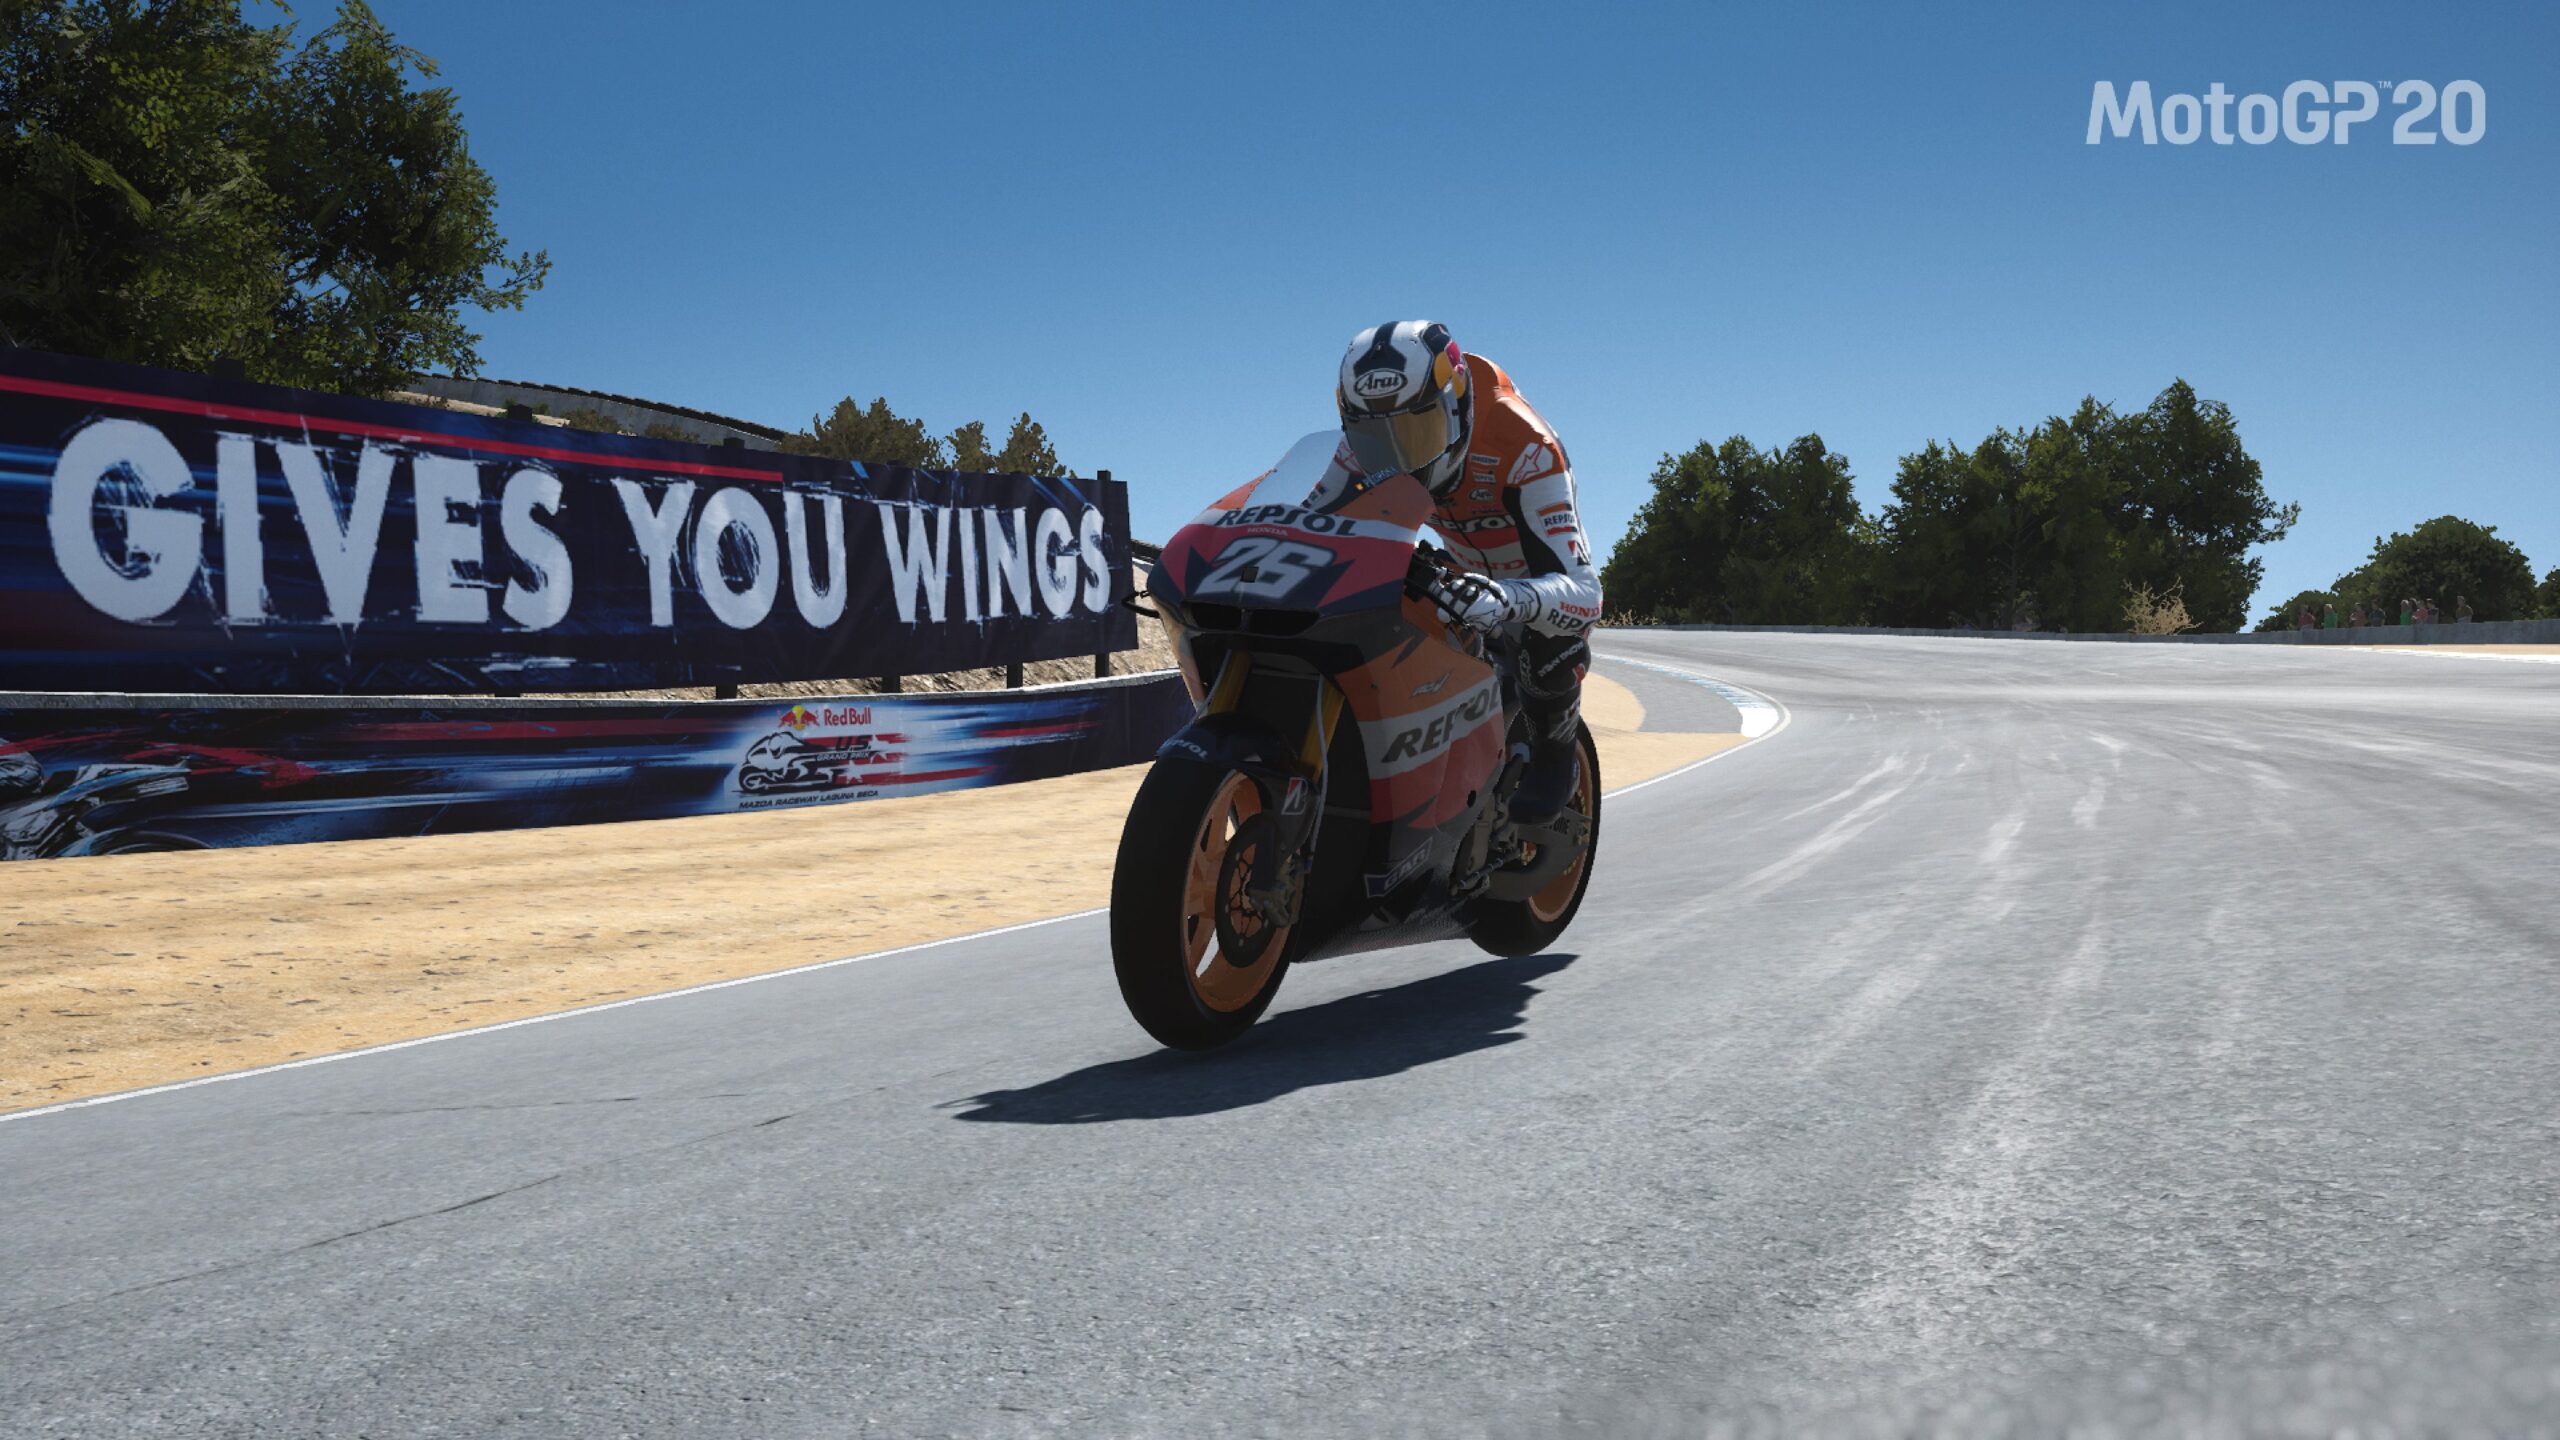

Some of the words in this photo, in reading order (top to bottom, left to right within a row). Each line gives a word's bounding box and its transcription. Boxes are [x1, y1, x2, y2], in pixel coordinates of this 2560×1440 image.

[1359, 372, 1400, 392] Arai
[47, 417, 573, 632] GIVES
[611, 478, 848, 630] YOU
[878, 501, 1111, 624] WINGS
[1214, 504, 1357, 537] REPSOL
[1248, 527, 1288, 537] HONDA
[1194, 536, 1335, 599] 26
[1560, 601, 1603, 618] HOND
[824, 707, 847, 726] Red
[849, 706, 872, 725] Bull
[835, 735, 873, 752] U.S.
[816, 752, 848, 762] GRAND
[850, 751, 871, 760] PRIX
[739, 799, 773, 809] MAZDA
[775, 795, 819, 806] RACEWAY
[820, 792, 855, 803] LAGUNA
